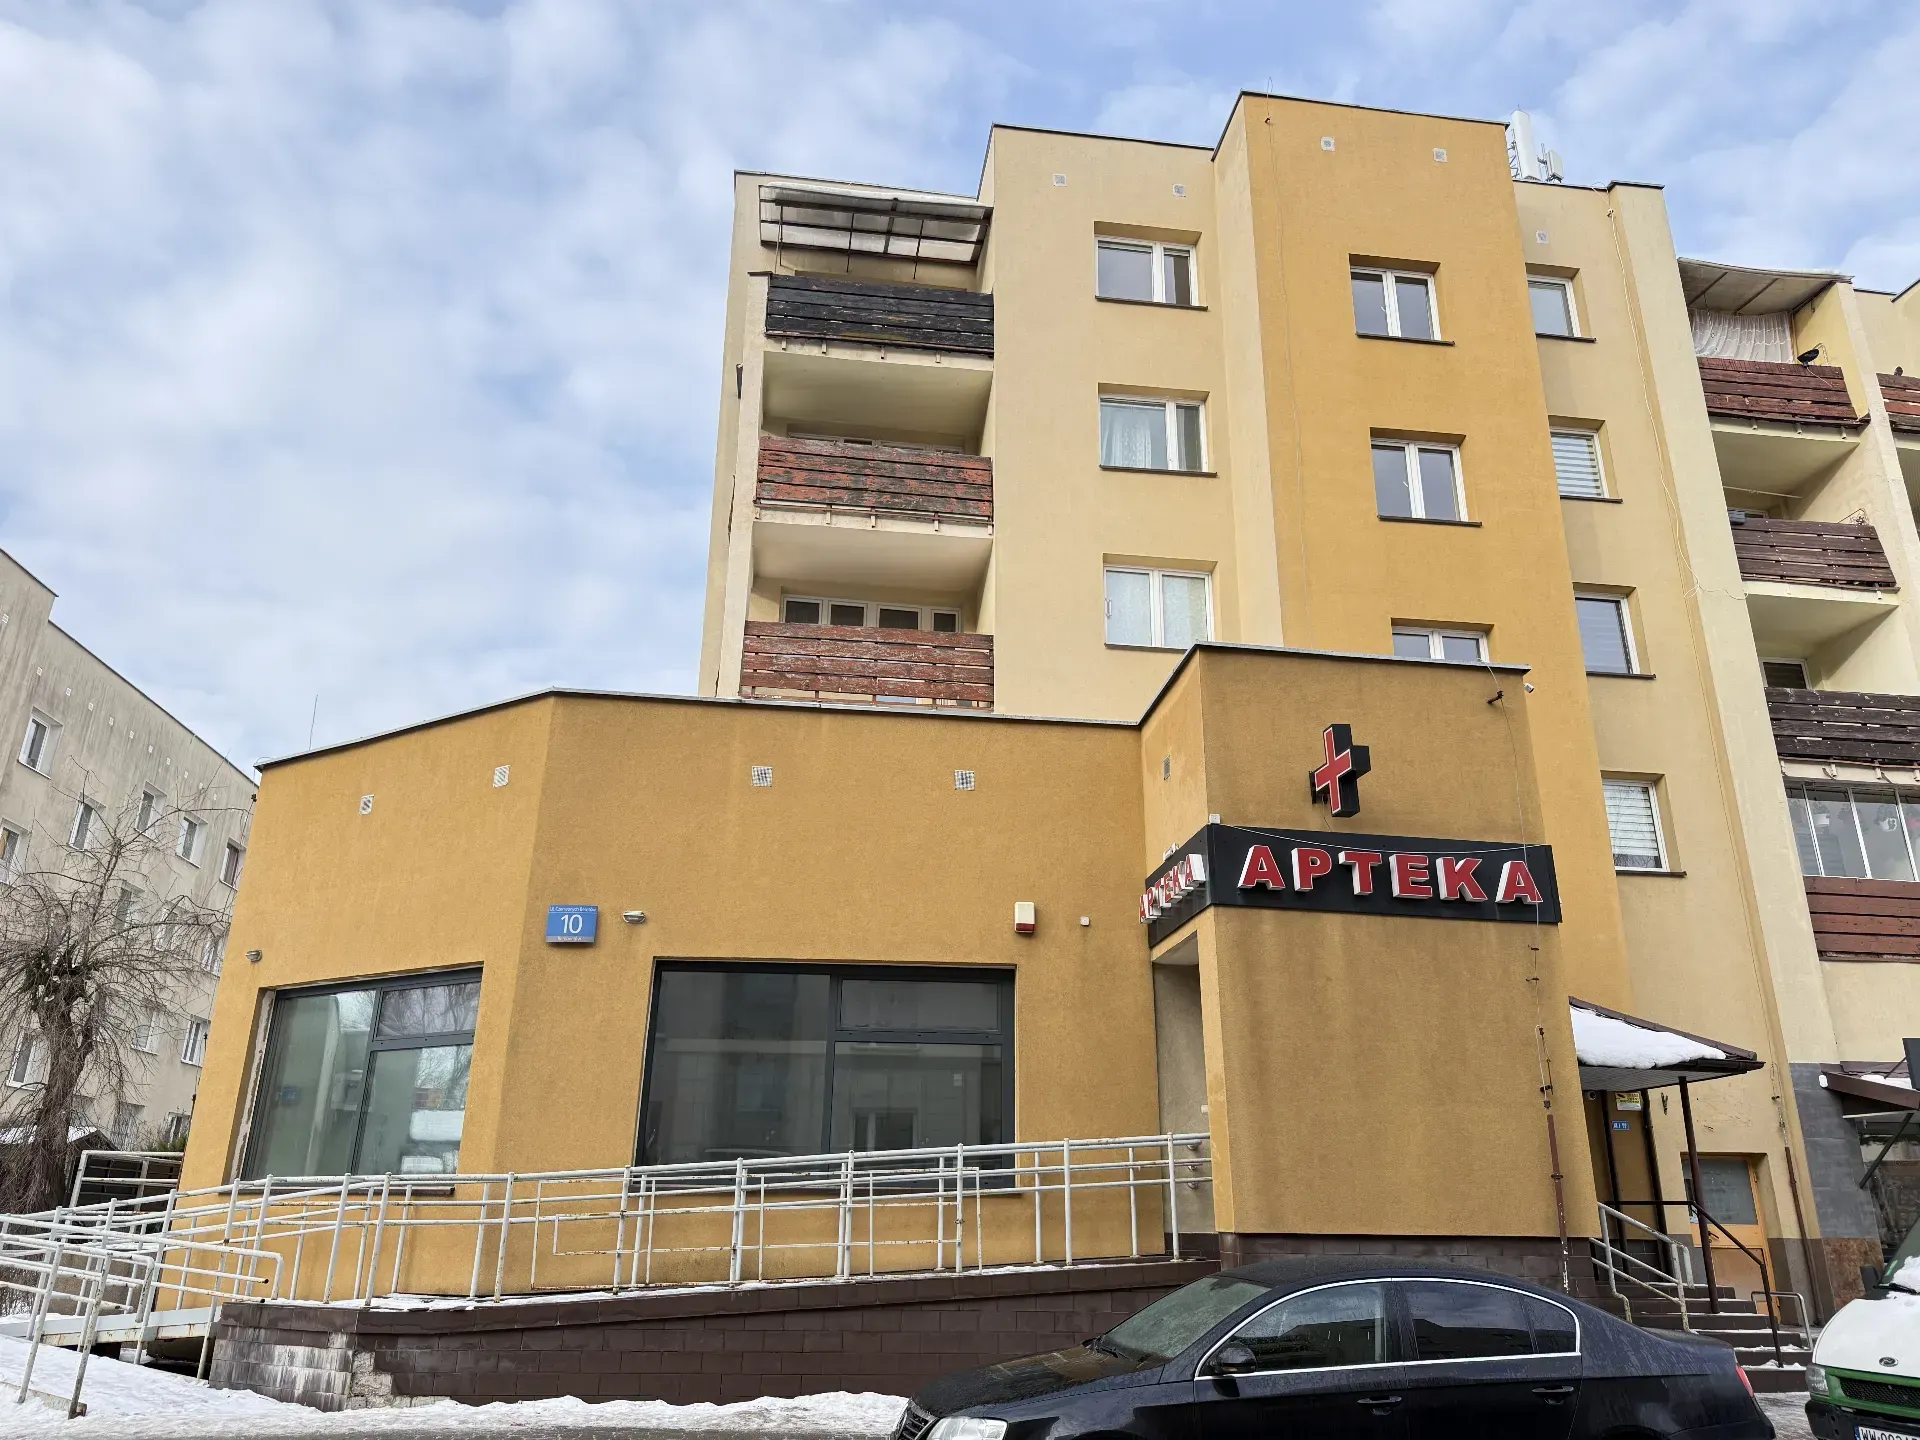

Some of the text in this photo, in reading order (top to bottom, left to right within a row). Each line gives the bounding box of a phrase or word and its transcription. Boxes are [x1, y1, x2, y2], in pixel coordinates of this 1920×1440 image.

[1139, 853, 1206, 924] APTEKA
[1238, 845, 1543, 904] APTEKA
[561, 914, 583, 934] 10
